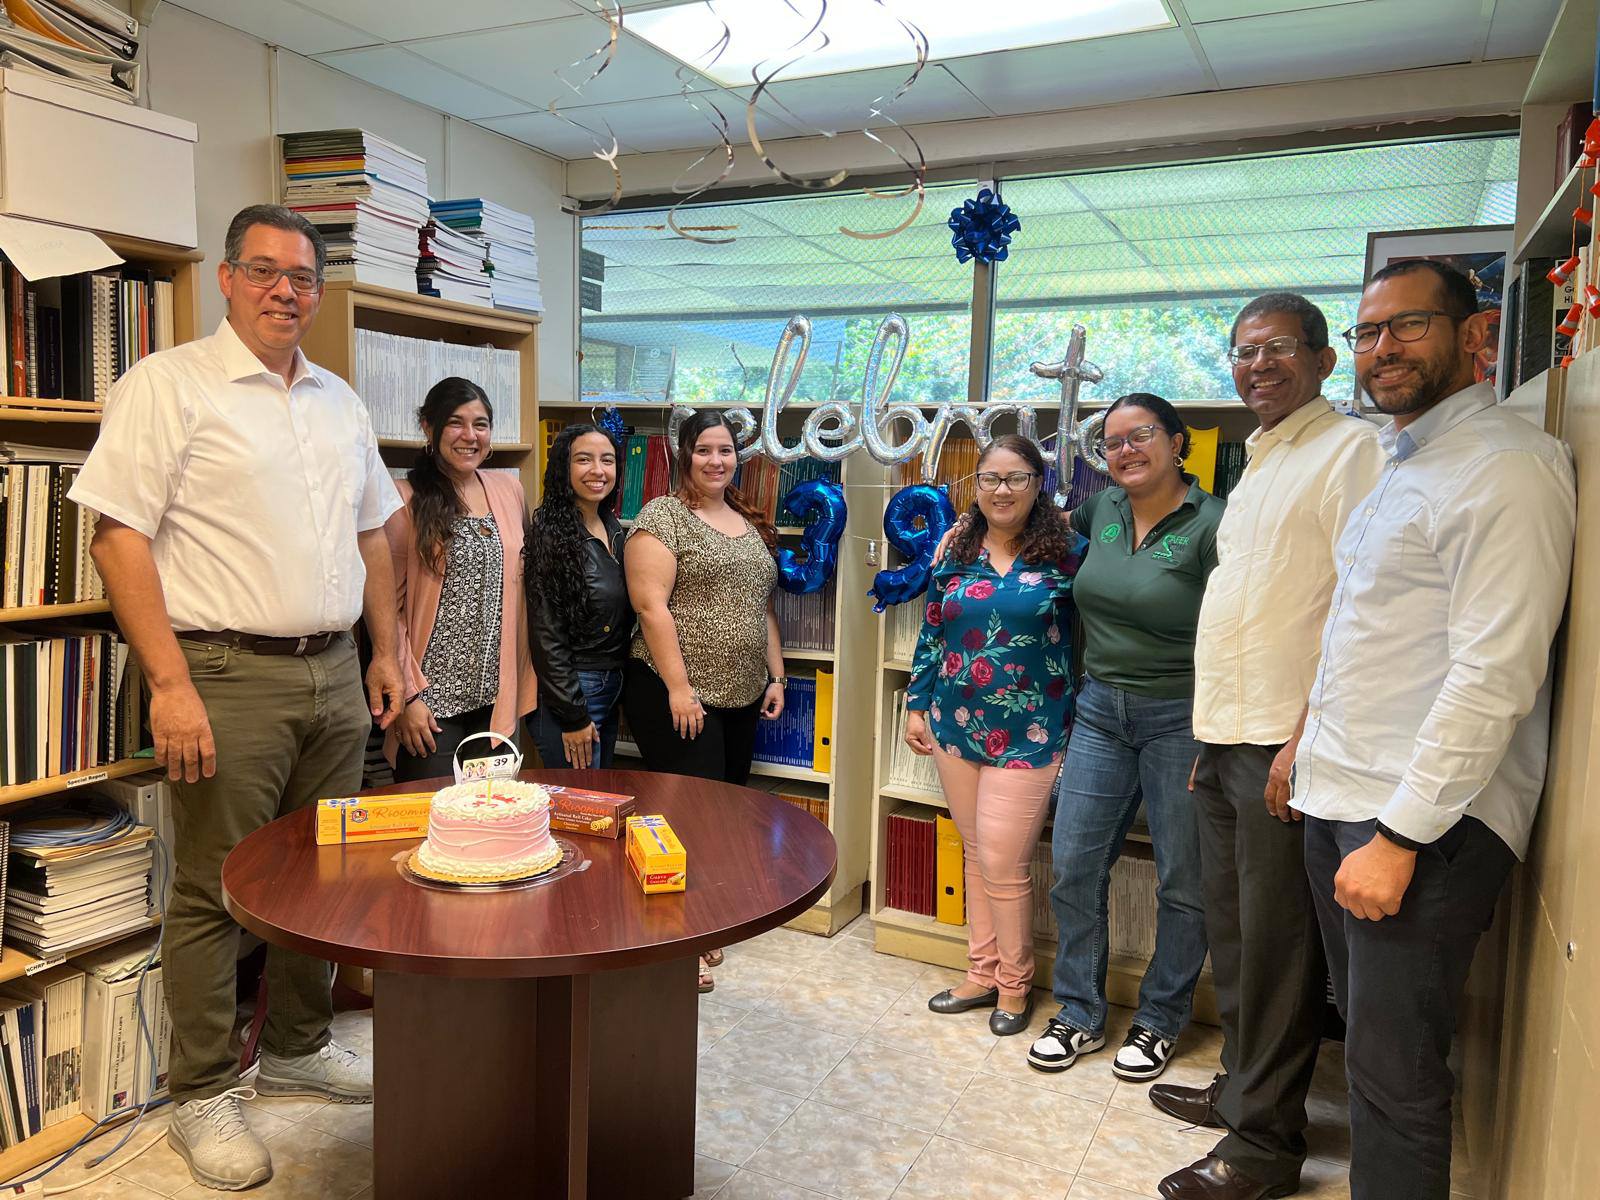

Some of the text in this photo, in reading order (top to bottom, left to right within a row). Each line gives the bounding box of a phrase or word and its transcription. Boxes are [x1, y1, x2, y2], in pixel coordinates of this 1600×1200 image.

[494, 757, 508, 767] 39
[67, 772, 106, 785] Special Report
